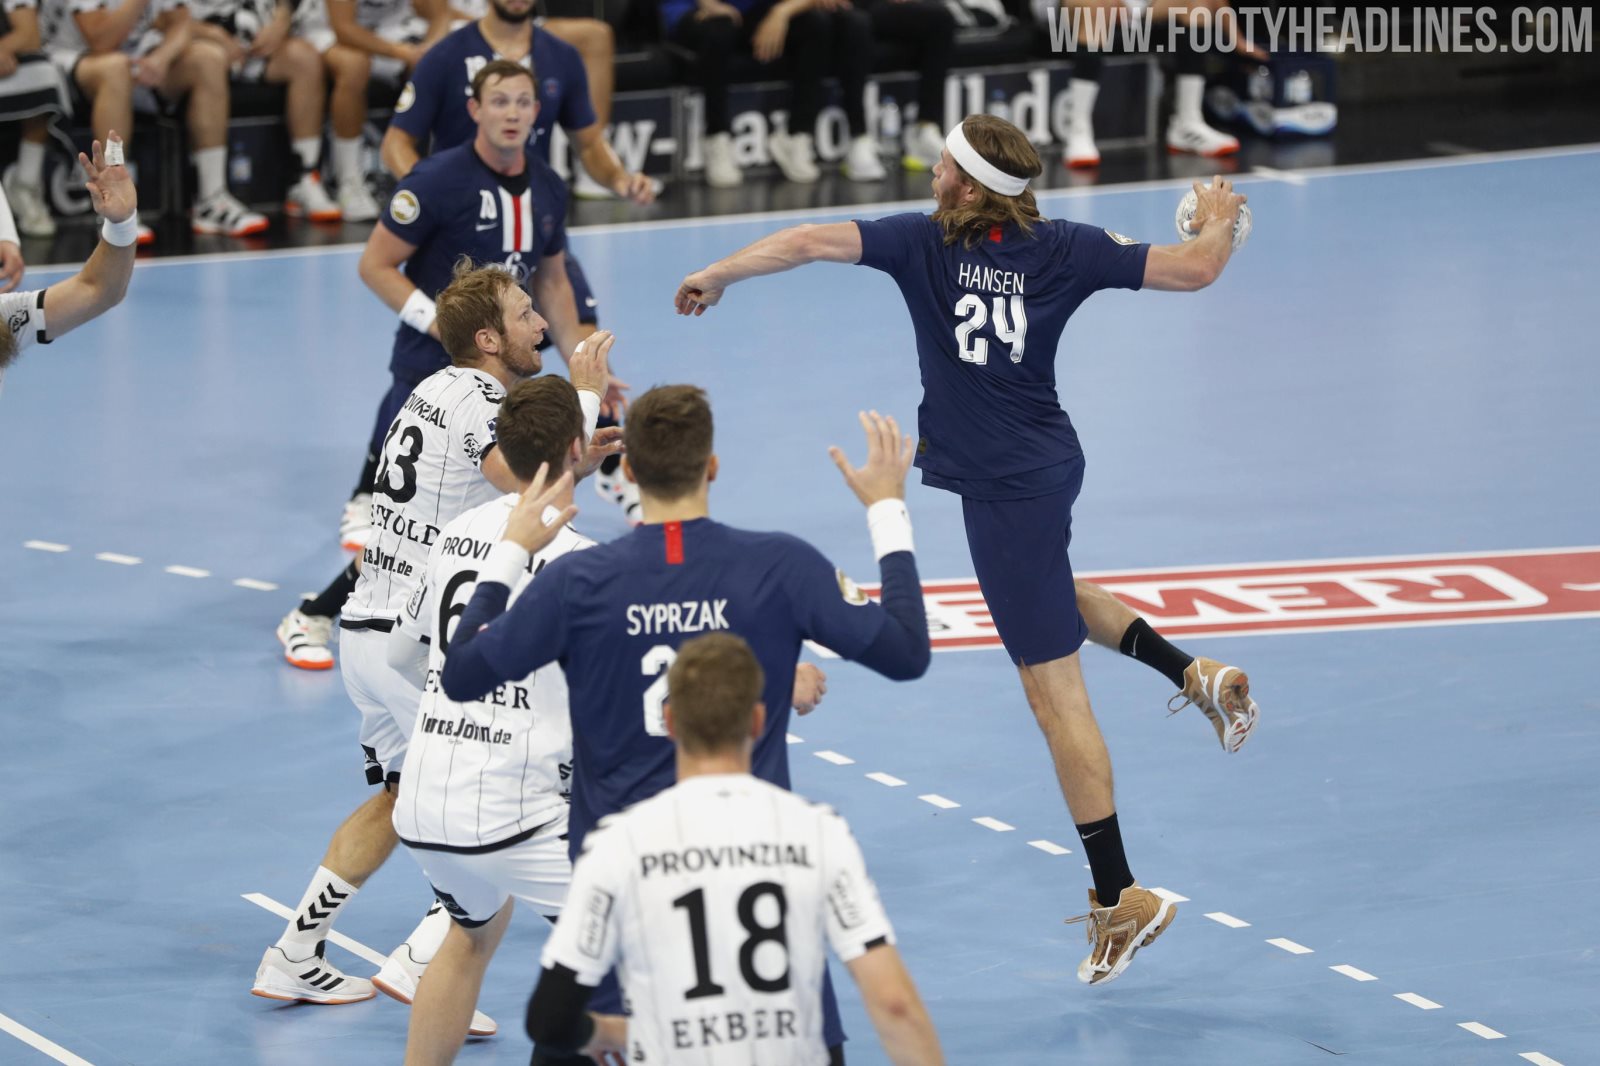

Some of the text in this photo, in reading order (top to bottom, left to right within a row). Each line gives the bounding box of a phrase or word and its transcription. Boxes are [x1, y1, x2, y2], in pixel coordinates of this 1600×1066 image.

[957, 262, 1025, 295] HANSEN
[954, 293, 1028, 366] 24
[373, 418, 424, 504] 13
[626, 598, 730, 636] SYPRZAK
[640, 842, 814, 877] PROVINZIAL
[672, 880, 791, 1001] 18
